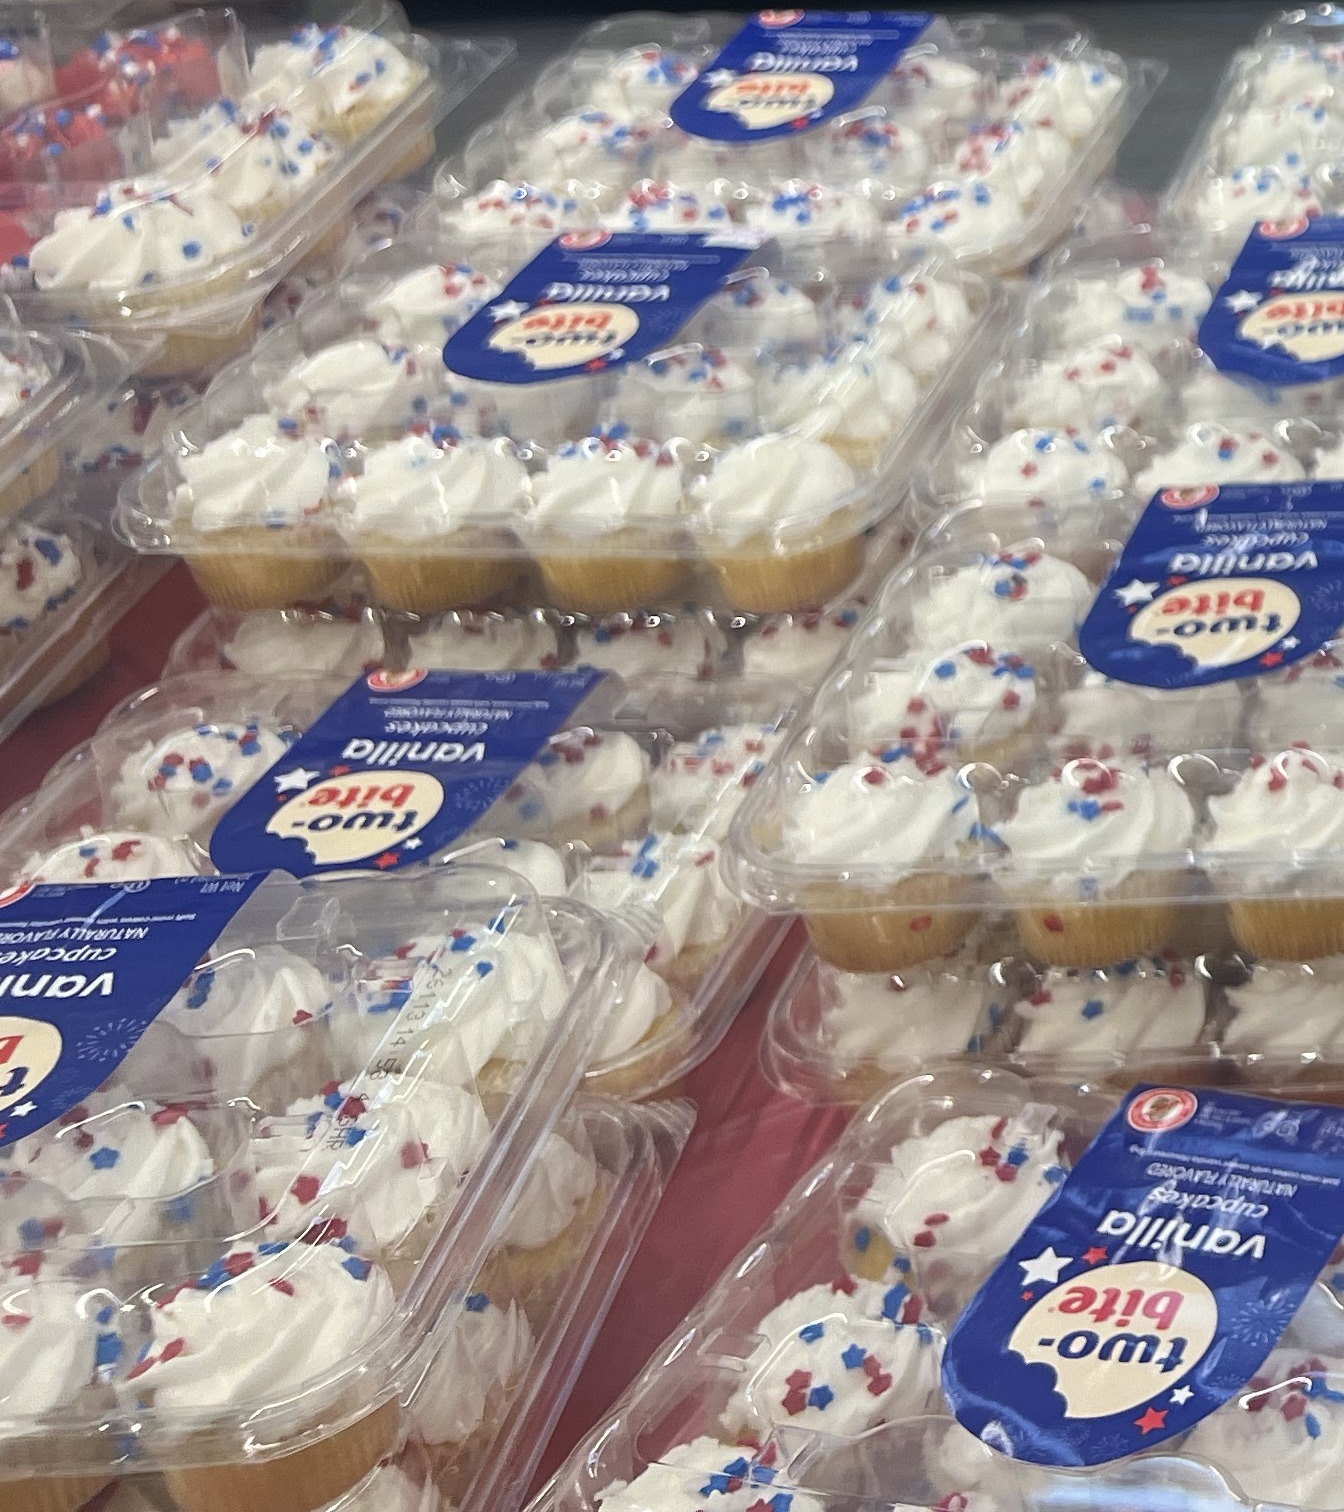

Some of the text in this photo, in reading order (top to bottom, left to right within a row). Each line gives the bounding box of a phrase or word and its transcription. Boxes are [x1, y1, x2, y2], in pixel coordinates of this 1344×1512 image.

[1168, 550, 1319, 576] vanilla
[1160, 588, 1266, 617] bite
[1155, 612, 1283, 637] two-
[340, 736, 487, 767] vanilla
[308, 782, 416, 810] bite
[292, 809, 419, 834] two-
[61, 926, 149, 942] NATURALLY
[1145, 1161, 1218, 1185] FLAVORED
[1217, 1172, 1298, 1198] NATURALLY
[1147, 1185, 1270, 1220] cupcakes
[1097, 1208, 1267, 1261] vanilla
[1058, 1284, 1186, 1333] bite
[1038, 1329, 1190, 1374] two-
